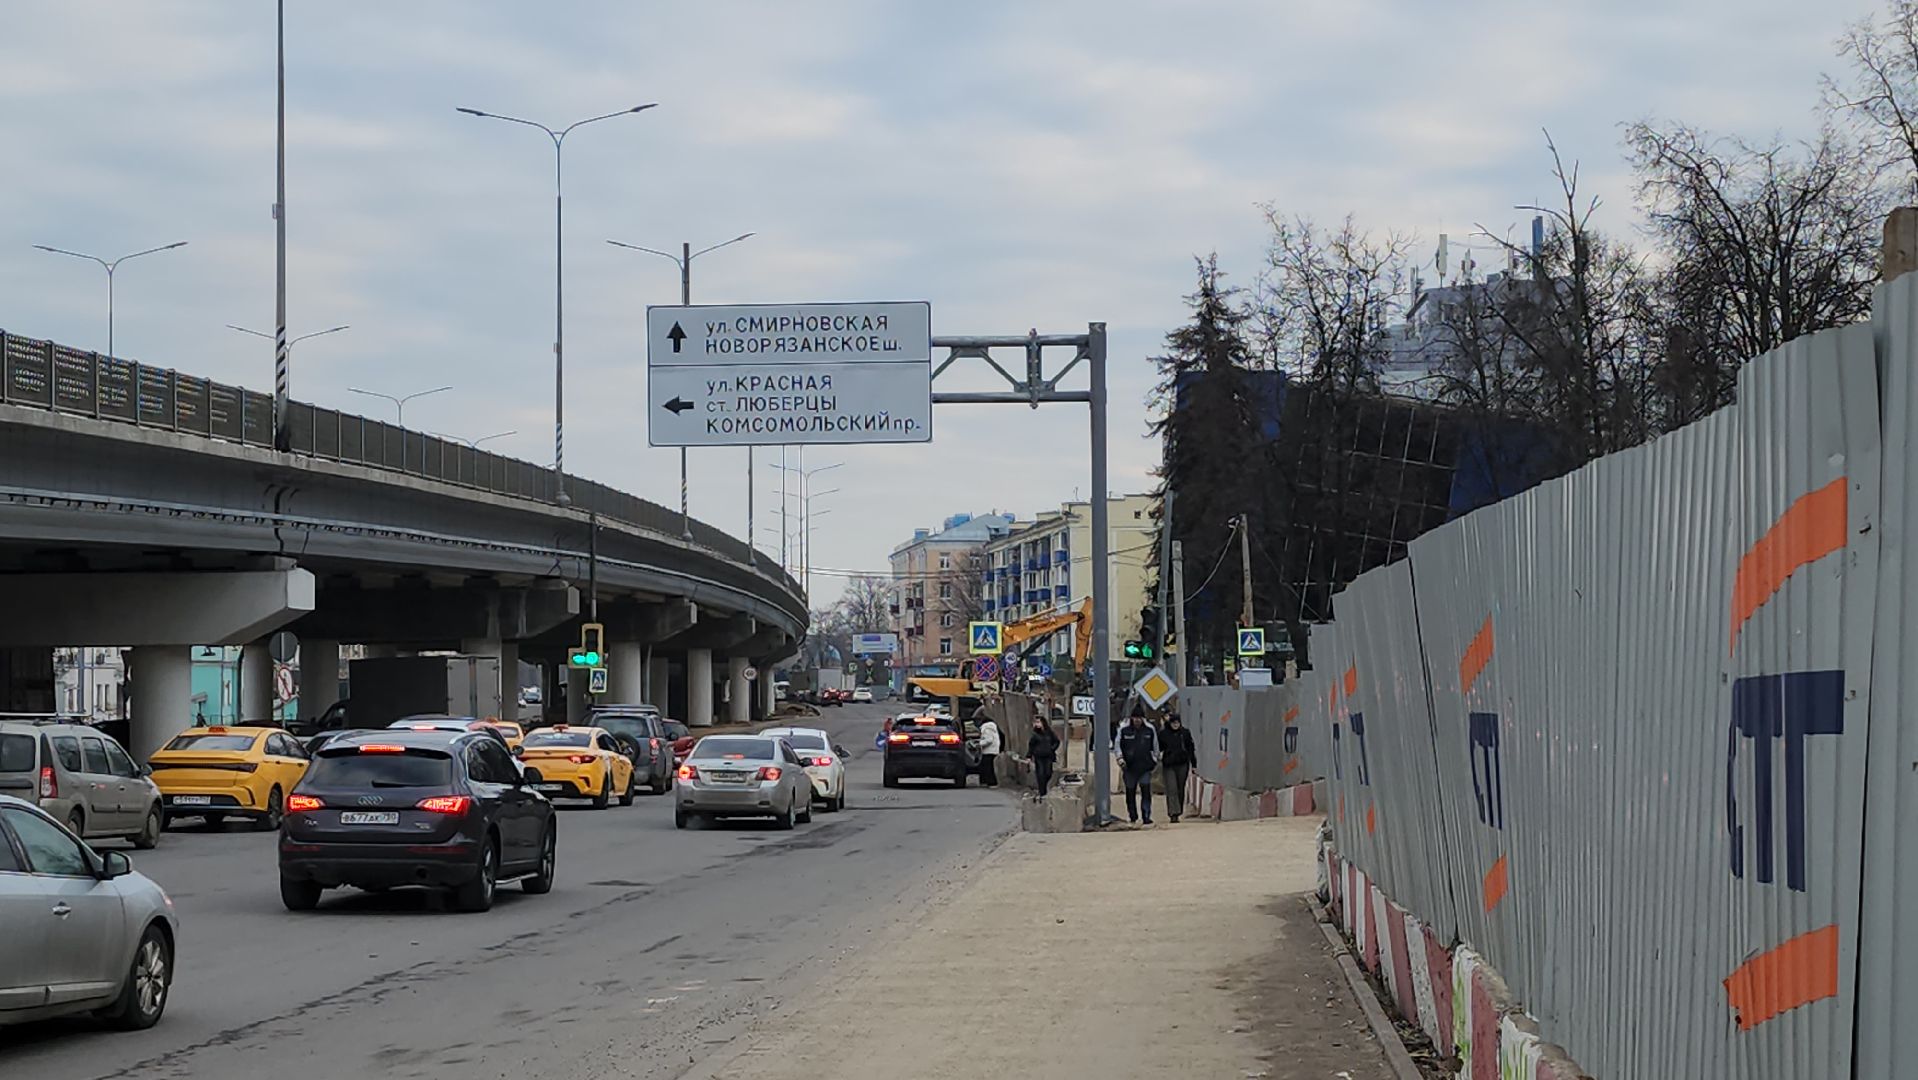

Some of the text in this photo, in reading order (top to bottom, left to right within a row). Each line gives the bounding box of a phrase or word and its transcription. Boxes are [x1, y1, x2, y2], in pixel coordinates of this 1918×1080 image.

[706, 316, 888, 338] ул. СМИРНОВСКАЯ
[706, 336, 880, 354] НОВОРЯЗАНСКОЕ
[707, 375, 832, 397] ул. КРАСНАЯ
[707, 396, 837, 413] ст. ЛЮБЕРЦЫ
[707, 411, 921, 434] КОМСОМОЛЬСКИЙ пр.
